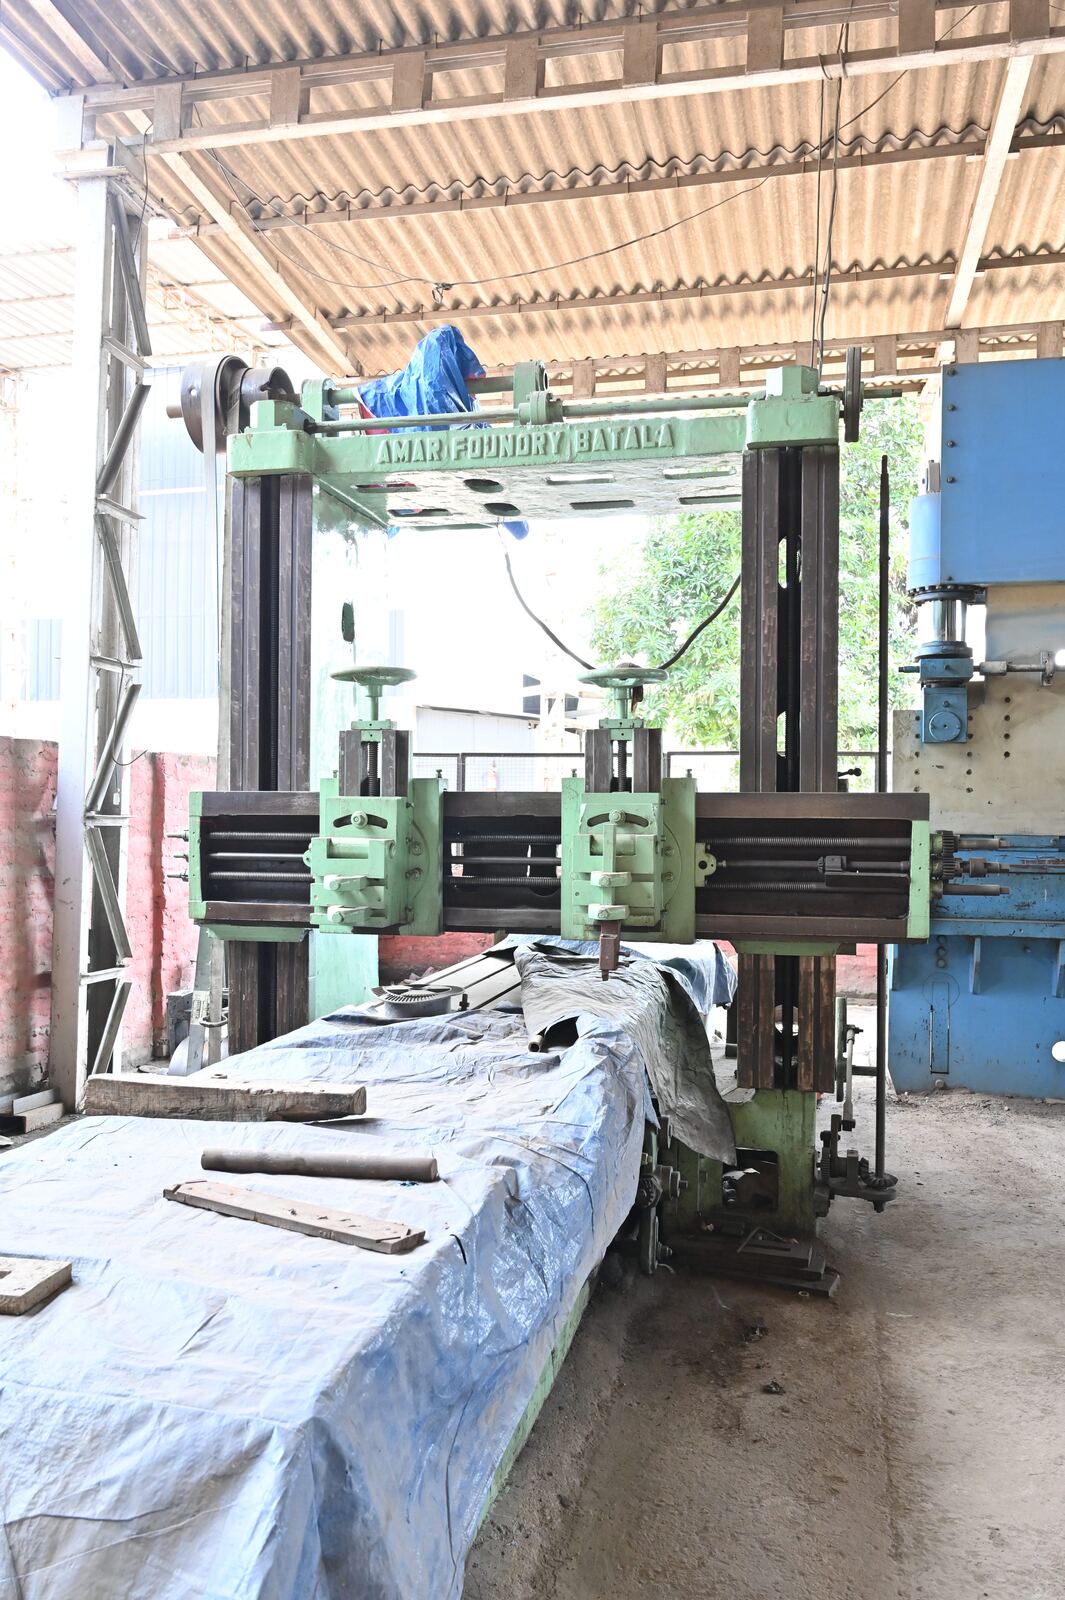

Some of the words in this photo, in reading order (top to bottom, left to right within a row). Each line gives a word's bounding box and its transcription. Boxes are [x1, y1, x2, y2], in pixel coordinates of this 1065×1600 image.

[376, 438, 445, 465] AMAR
[451, 431, 560, 460] FOUNDRY
[574, 424, 676, 452] BATALA
